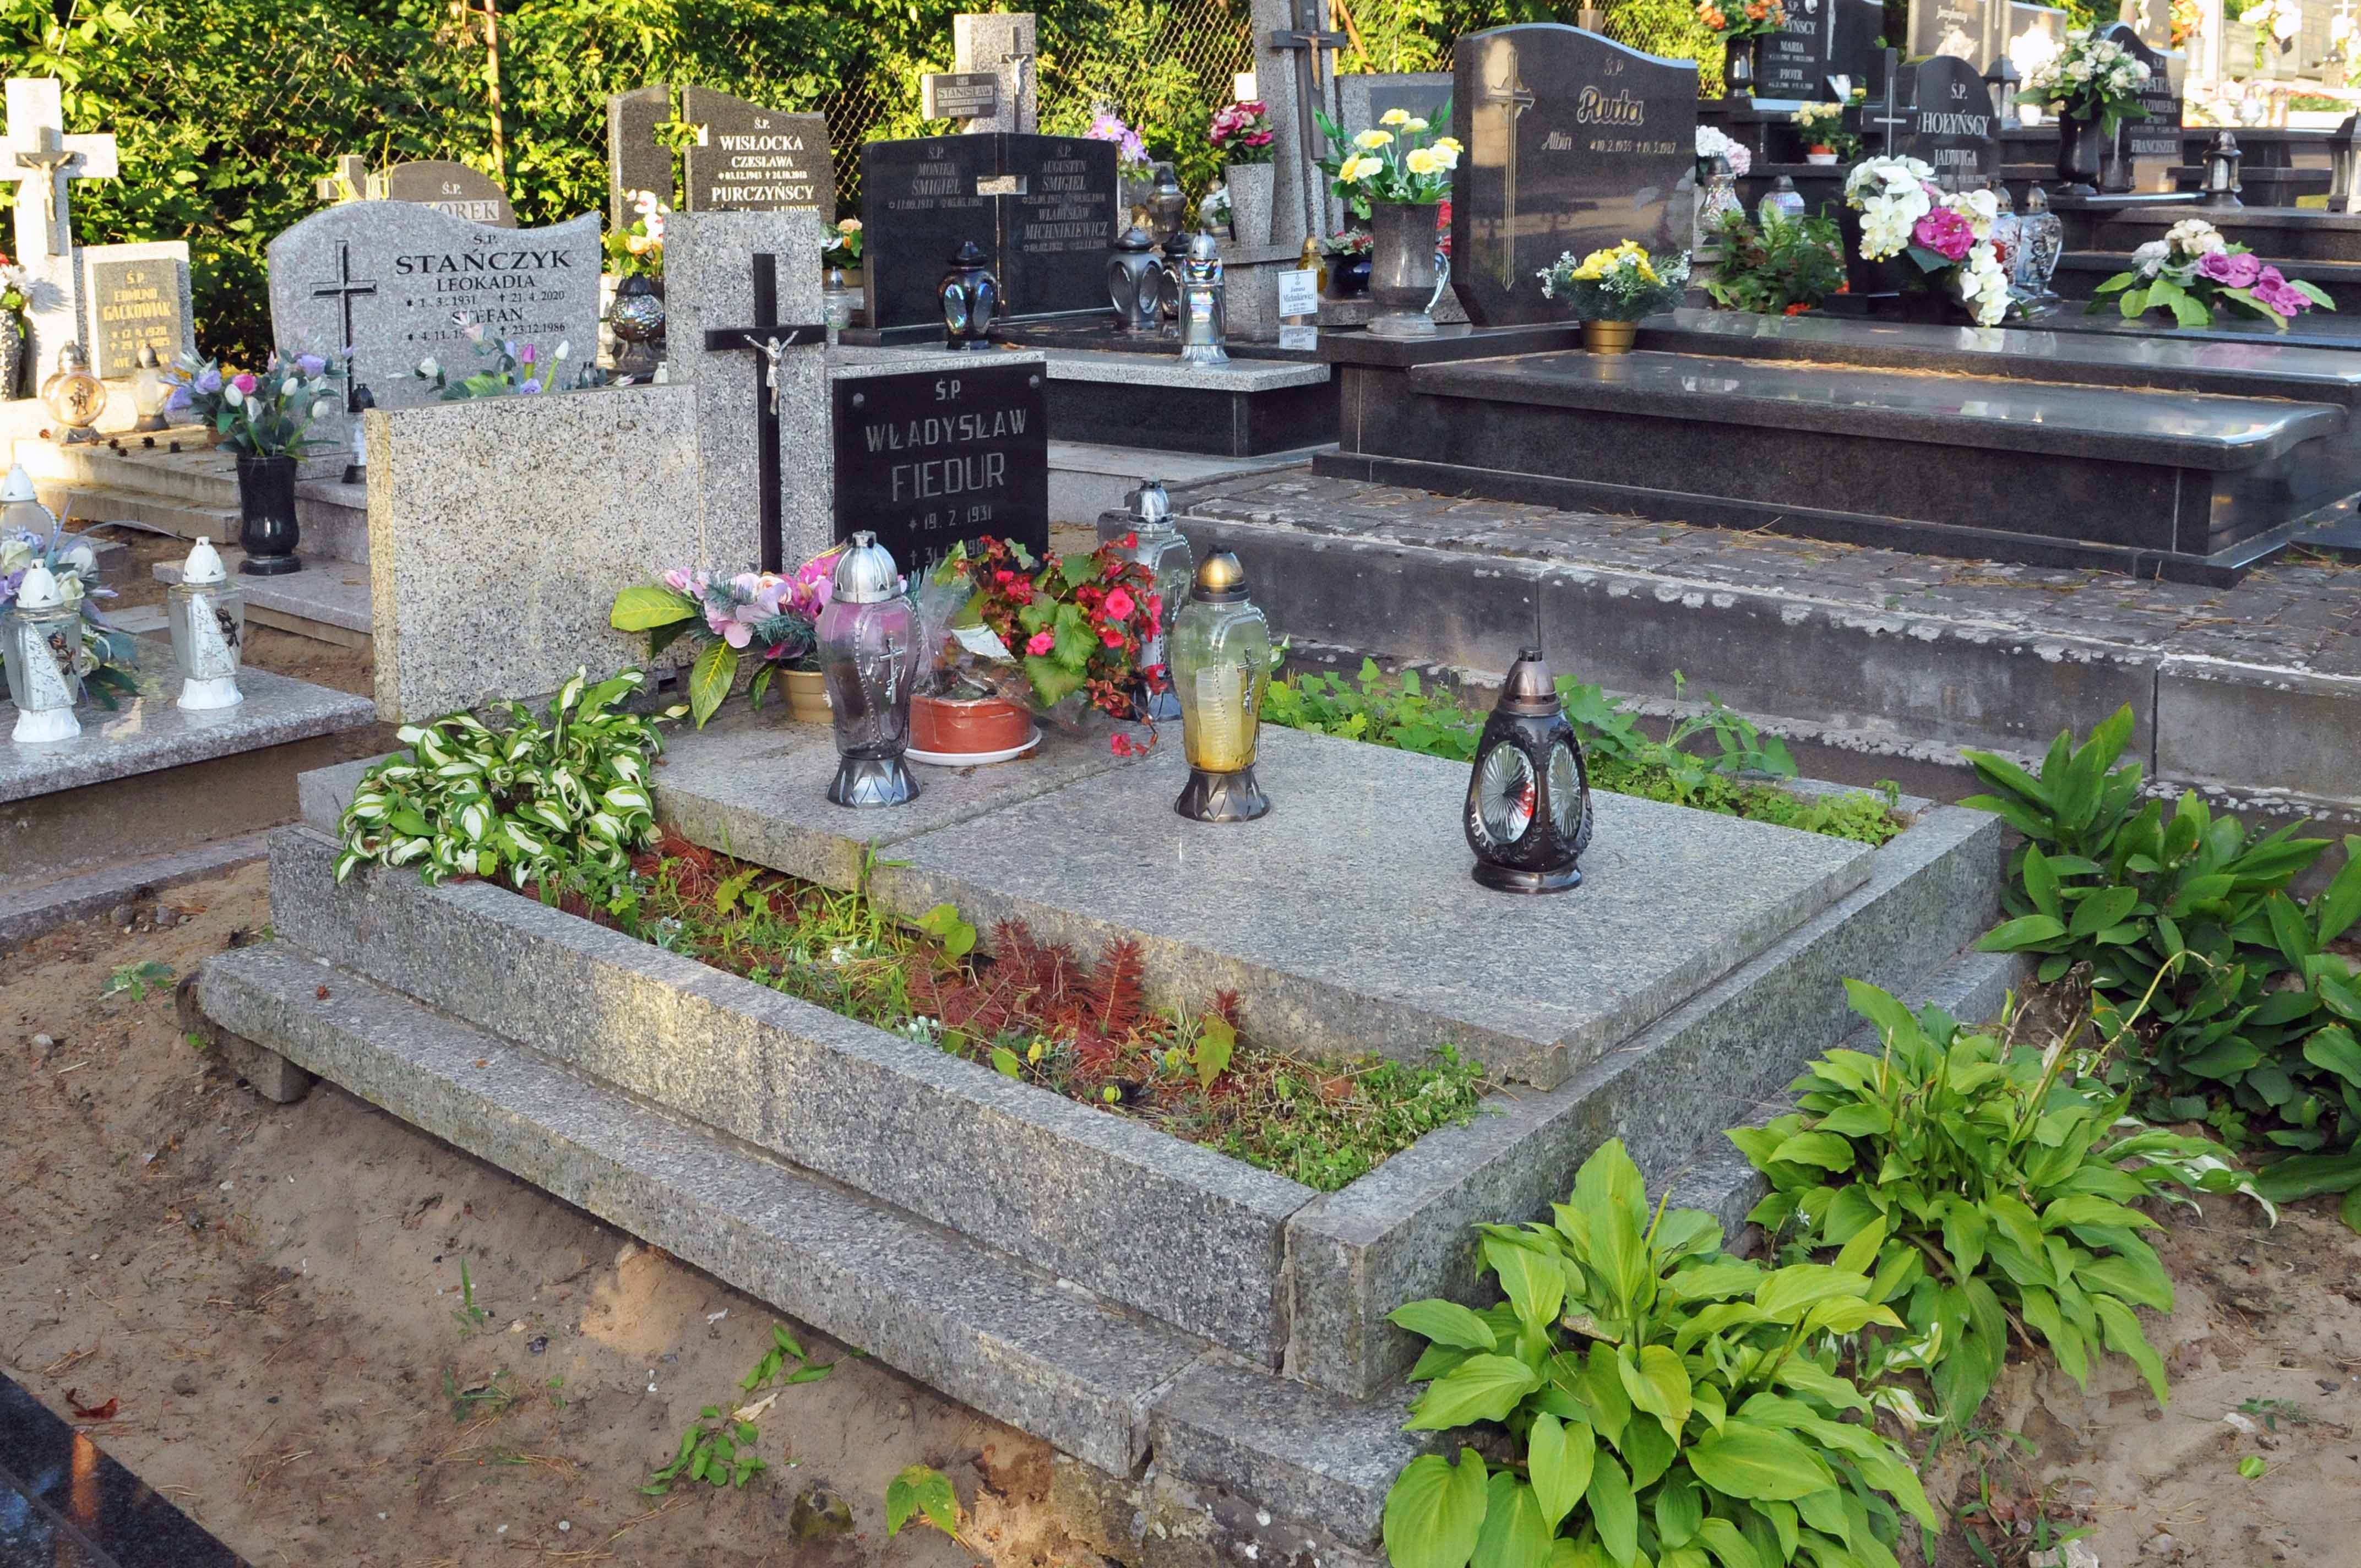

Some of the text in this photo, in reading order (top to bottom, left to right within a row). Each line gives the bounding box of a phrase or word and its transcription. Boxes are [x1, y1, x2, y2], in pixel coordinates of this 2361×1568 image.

[1951, 79, 1968, 99] Ś.P.
[1577, 85, 1644, 126] Ruta
[2136, 99, 2177, 113] AZIMIERA
[754, 117, 770, 129] Ś.P.
[1922, 109, 1990, 135] HOŁYŃSCY
[719, 135, 804, 150] WISŁOCKA
[1541, 131, 1572, 150] Albin
[1042, 160, 1087, 173] AUGUSTYN
[1934, 149, 1977, 169] JADWIGA
[918, 163, 956, 176] MONIKA
[711, 182, 814, 202] PURCZYŃSCY
[912, 176, 961, 196] ŚMIGIEL
[1024, 221, 1108, 239] MICHNIKIEWICZ
[396, 249, 572, 275] STAŃCZYK
[438, 275, 535, 292] LEOKADIA
[114, 288, 158, 302] EDMUND
[541, 290, 564, 301] 2020
[102, 301, 171, 321] GACKOWIAK
[865, 409, 1026, 452] WŁADYSŁAW
[892, 453, 1005, 502] FIEDUR
[967, 505, 992, 522] 1931
